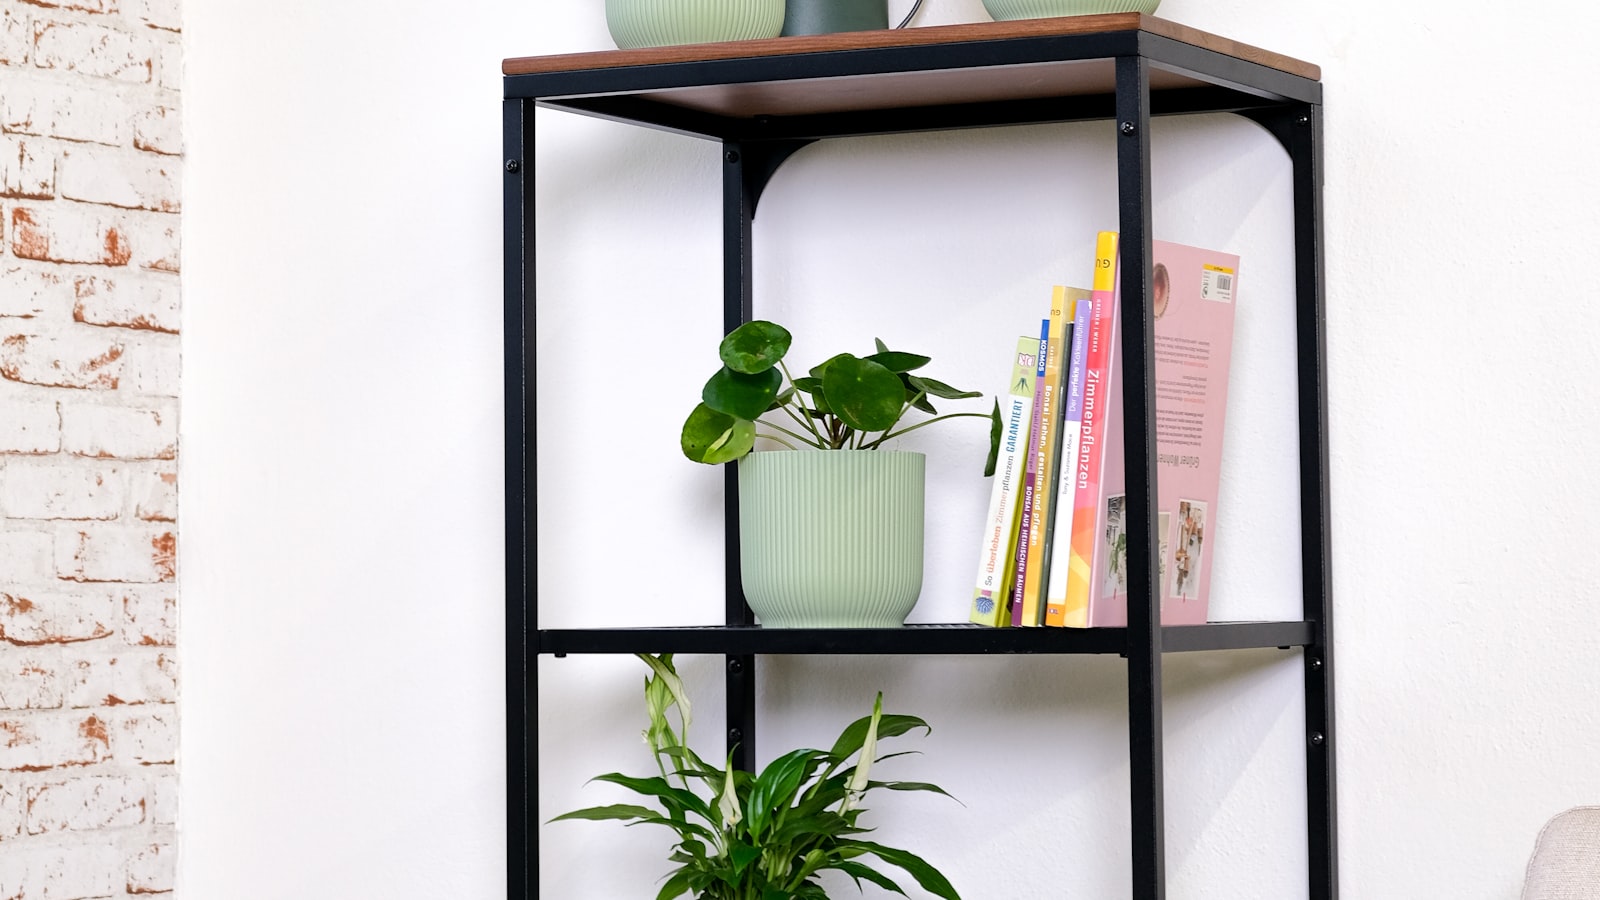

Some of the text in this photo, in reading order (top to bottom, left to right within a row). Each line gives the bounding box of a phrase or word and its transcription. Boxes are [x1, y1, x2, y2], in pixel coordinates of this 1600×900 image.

[1039, 340, 1048, 372] KOSMOS
[1068, 399, 1077, 412] Der
[1070, 366, 1081, 397] perfekte
[1030, 385, 1053, 547] Bonsai ziehen, gestalten und pflegen
[1078, 368, 1099, 490] Zimmerpflanzen
[984, 399, 1023, 586] So überleben Zimmerpflanzen GARANTIERT
[1014, 486, 1033, 604] BONSAI AUS HEIMISCHEN BÄUMEN
